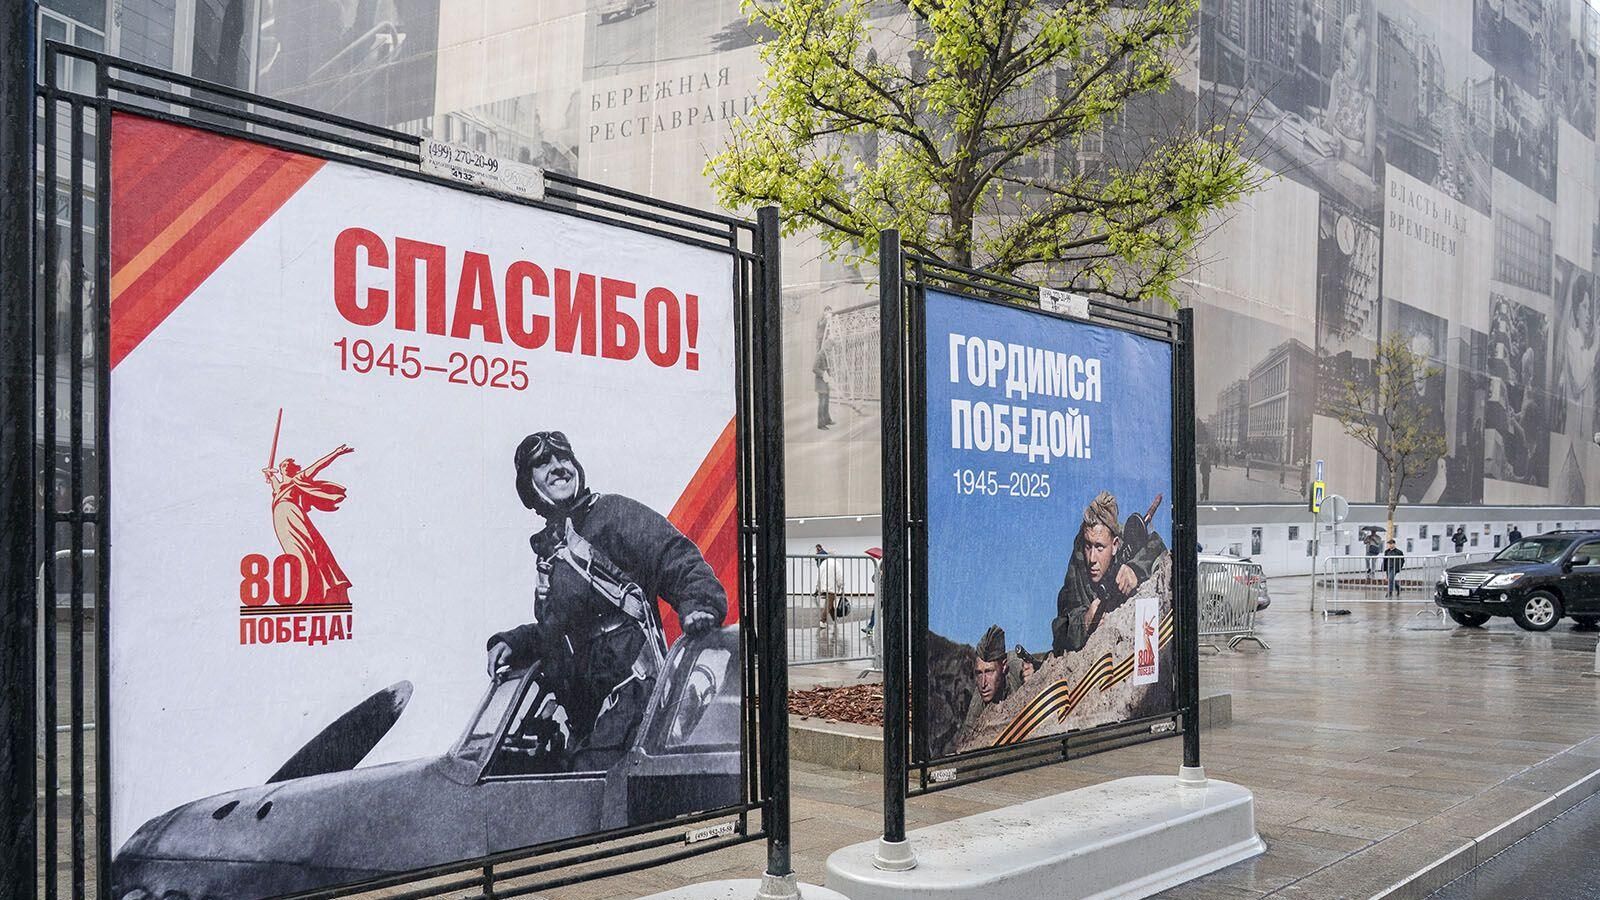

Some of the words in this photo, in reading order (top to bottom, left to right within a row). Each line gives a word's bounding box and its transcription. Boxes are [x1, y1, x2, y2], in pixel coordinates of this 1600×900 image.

[591, 67, 730, 112] БЕРЕЖНАЯ
[590, 95, 760, 143] РЕСТАВРАЦИ
[428, 141, 452, 163] (499)
[454, 149, 499, 173] 270-20-99
[1391, 181, 1438, 219] ВЛАСТЬ
[1444, 207, 1468, 235] НАД
[1390, 211, 1456, 256] ВРЕМЕНЕМ
[334, 227, 699, 371] СПАСИБО!
[334, 336, 530, 391] 1945–2025
[949, 333, 1102, 403] ГОРДИМСЯ
[951, 399, 1092, 464] ПОБЕДОЙ!
[953, 469, 1051, 498] 1945–2025
[240, 553, 303, 606] 80
[240, 615, 353, 646] ПОБЕДА!
[1138, 649, 1149, 666] 80
